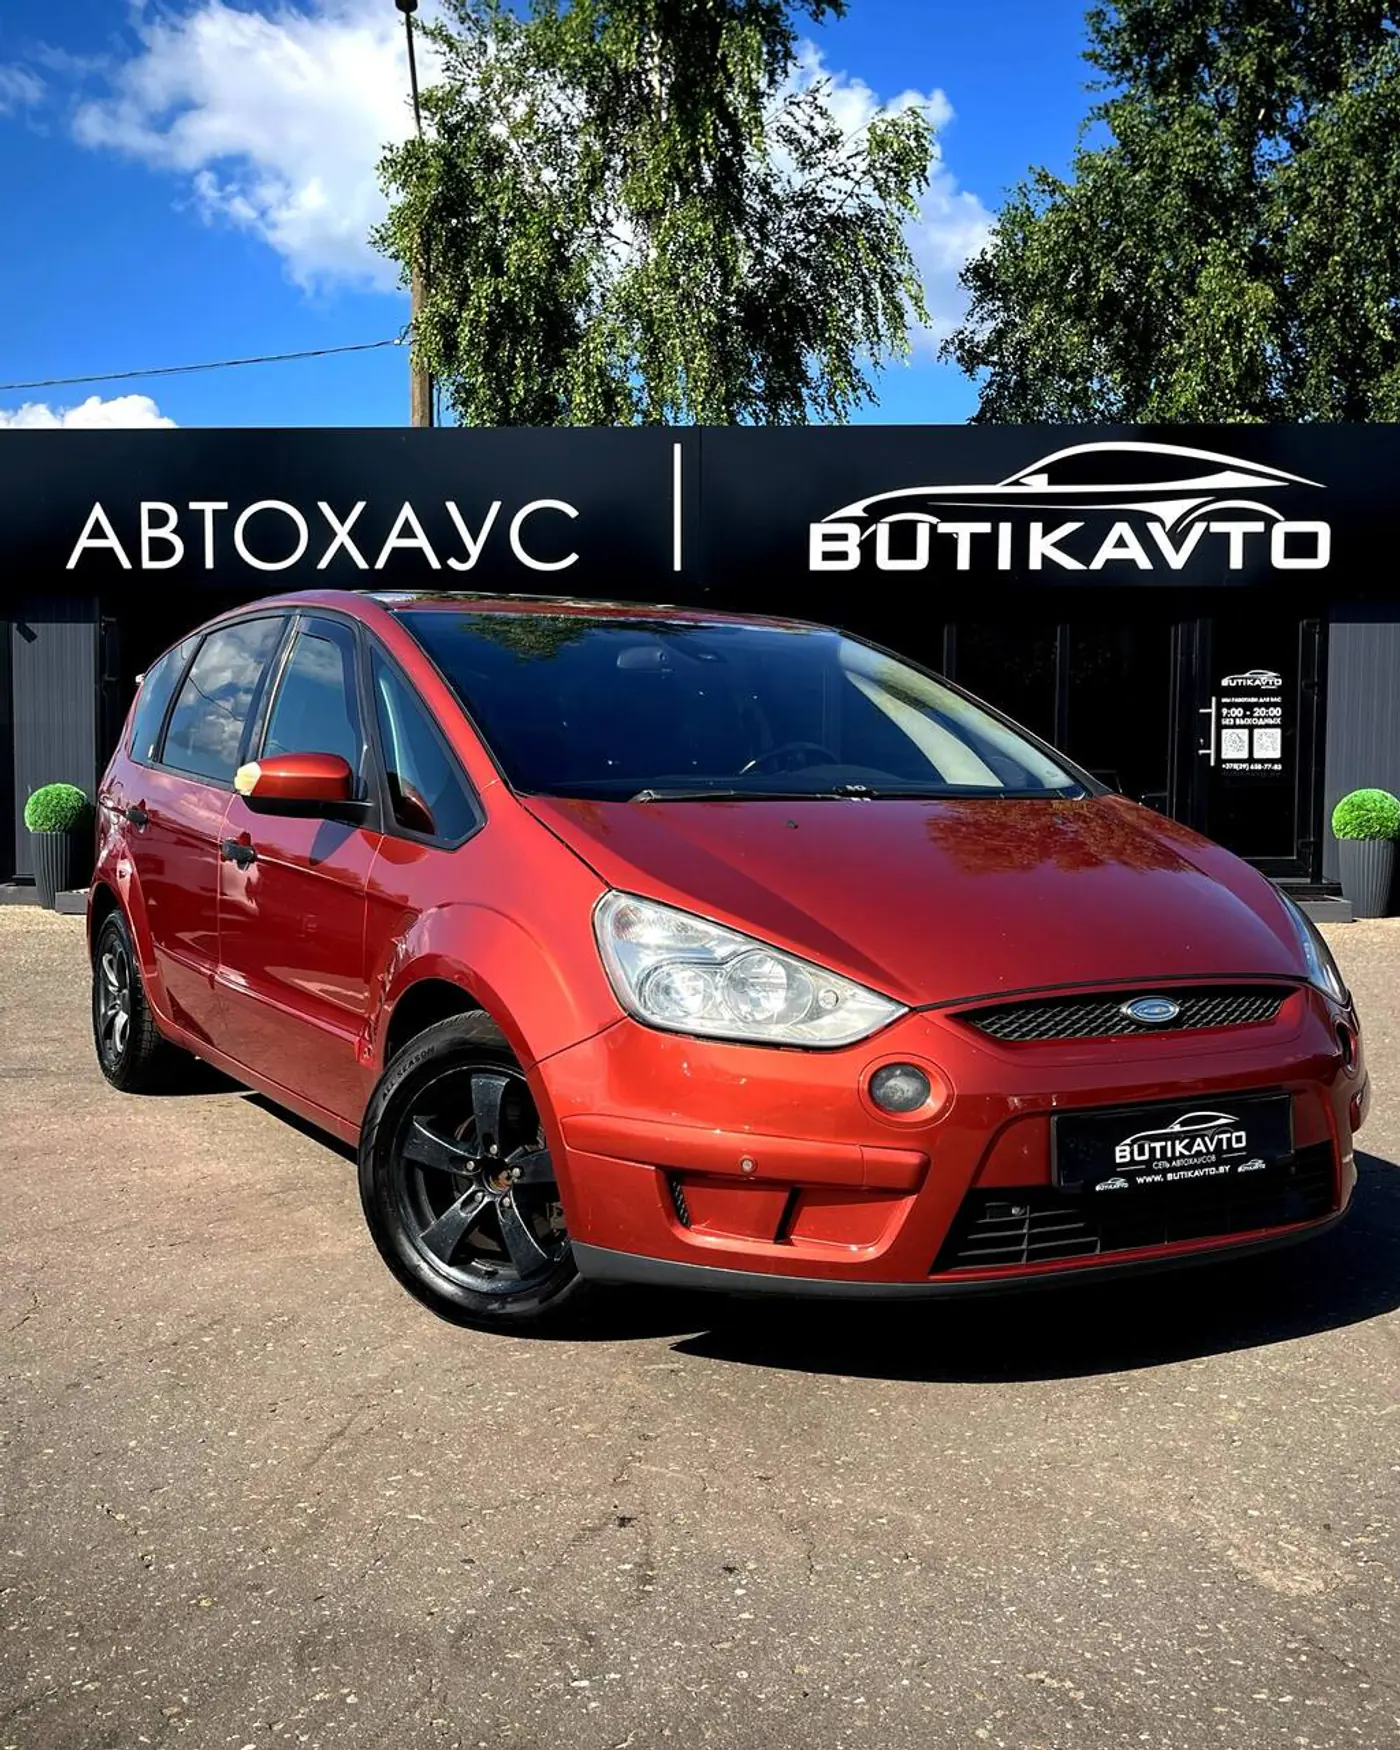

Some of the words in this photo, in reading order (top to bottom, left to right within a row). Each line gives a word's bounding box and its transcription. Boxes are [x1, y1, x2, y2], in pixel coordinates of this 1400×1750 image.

[65, 499, 580, 572] АВТОХАУС
[808, 520, 1332, 572] BUTIKAVTO
[1221, 707, 1244, 717] 9:00
[1252, 707, 1282, 717] 20:00
[1114, 1131, 1247, 1164] BUTIKAVTO
